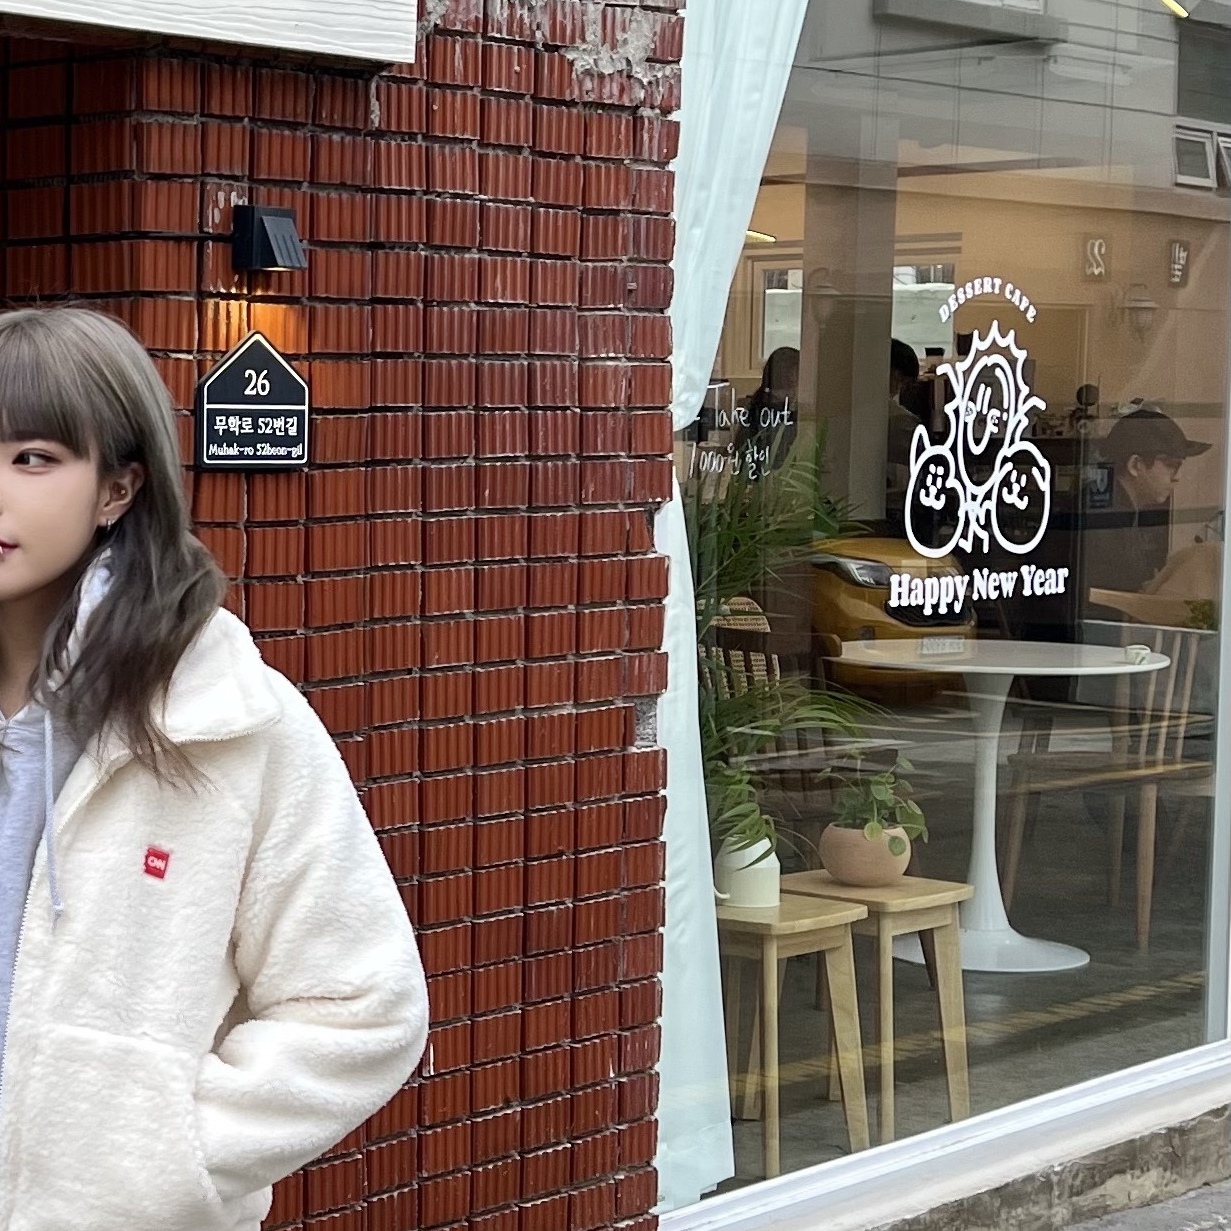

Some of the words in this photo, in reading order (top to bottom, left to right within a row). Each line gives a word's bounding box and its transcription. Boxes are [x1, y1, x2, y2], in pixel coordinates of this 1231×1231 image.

[938, 276, 1002, 323] DESSERT
[1005, 283, 1037, 323] CAFE
[243, 369, 270, 396] 26
[213, 415, 254, 436] 무학로
[257, 416, 298, 436] 52번길
[707, 382, 751, 428] Take
[759, 396, 794, 428] out
[208, 442, 254, 456] Muhak-ro
[256, 442, 303, 458] 52beon-gil
[689, 441, 742, 479] 1000원
[745, 438, 771, 480] 할인
[888, 573, 970, 616] Happy
[972, 567, 1018, 601] New
[1020, 564, 1069, 597] Year
